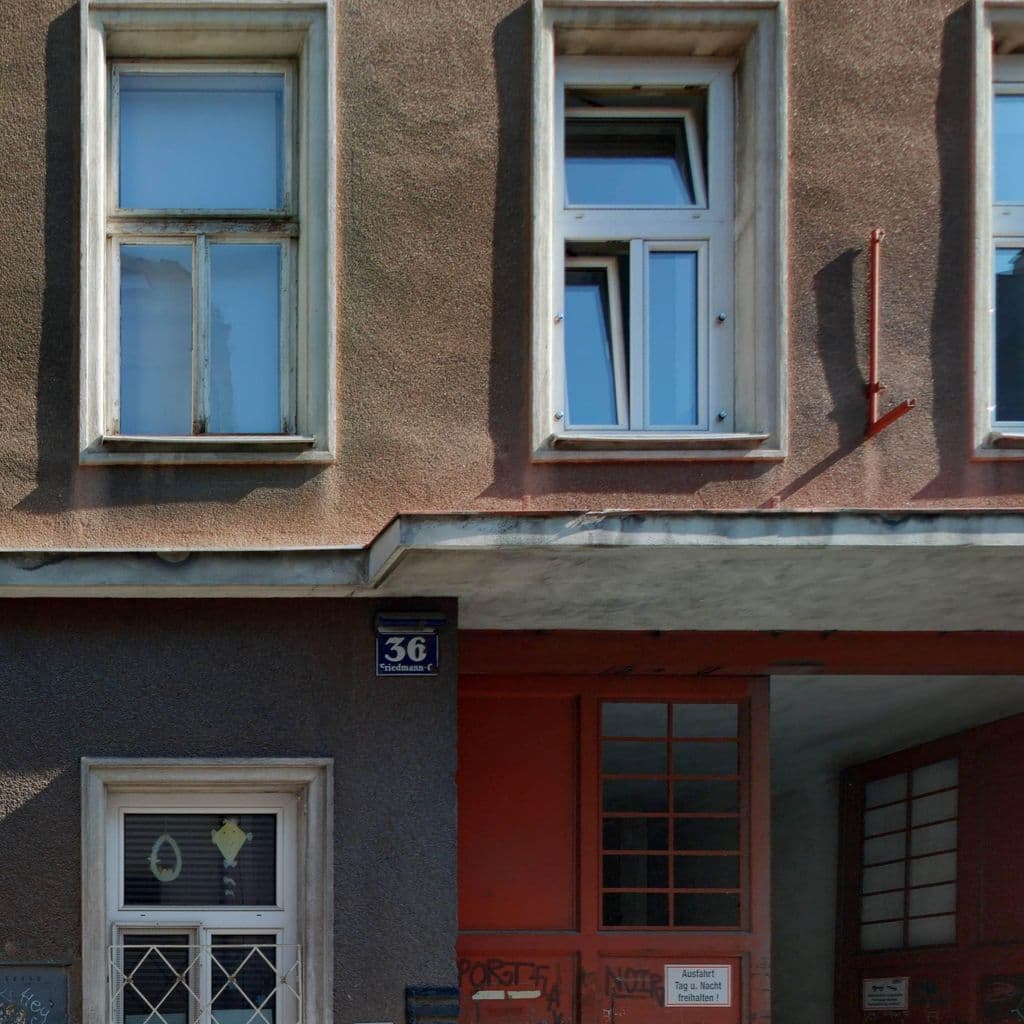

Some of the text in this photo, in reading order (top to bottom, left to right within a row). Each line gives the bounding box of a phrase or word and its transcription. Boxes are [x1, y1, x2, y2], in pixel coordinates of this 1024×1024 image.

[384, 636, 427, 662] 36
[681, 969, 715, 978] Ausfahrt
[674, 981, 722, 992] Tag u. Nacht
[678, 993, 714, 1002] freihalten
